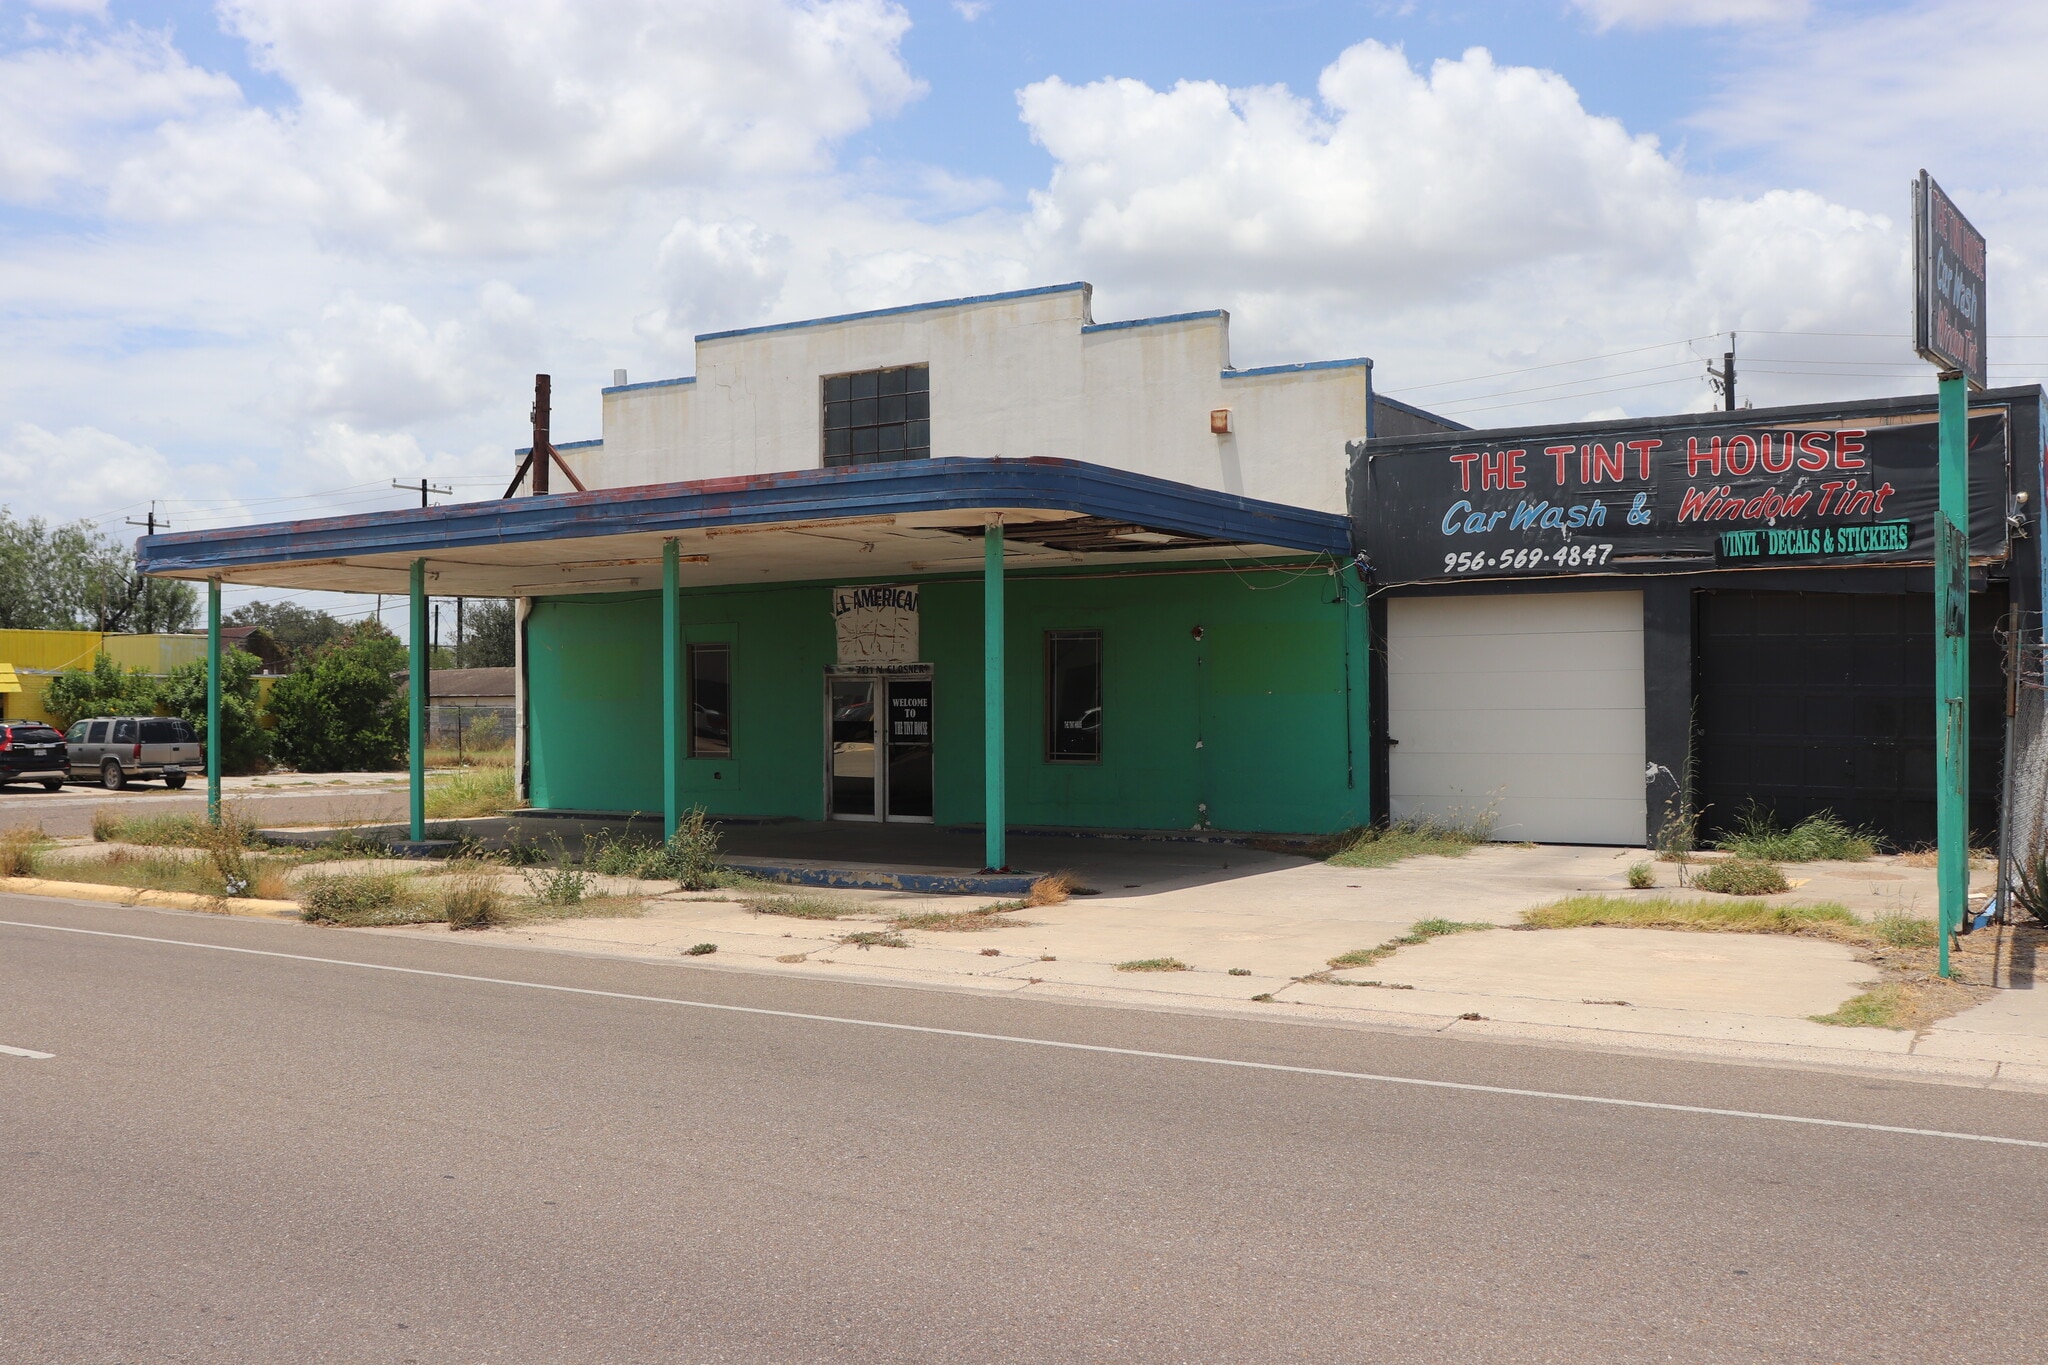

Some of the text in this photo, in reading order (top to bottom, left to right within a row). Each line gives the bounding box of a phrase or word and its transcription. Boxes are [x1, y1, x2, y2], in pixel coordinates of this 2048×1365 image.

[1937, 246, 1977, 327] Car Wash
[1449, 430, 1867, 492] THE TINT HOUSE
[1441, 479, 1895, 536] Car Wash & Window Tint
[1720, 531, 1760, 557] VINYL
[1823, 528, 1835, 553] &
[1837, 524, 1908, 553] STICKERS
[855, 665, 873, 674] 701
[892, 698, 928, 707] WELCOME
[904, 708, 916, 718] TO
